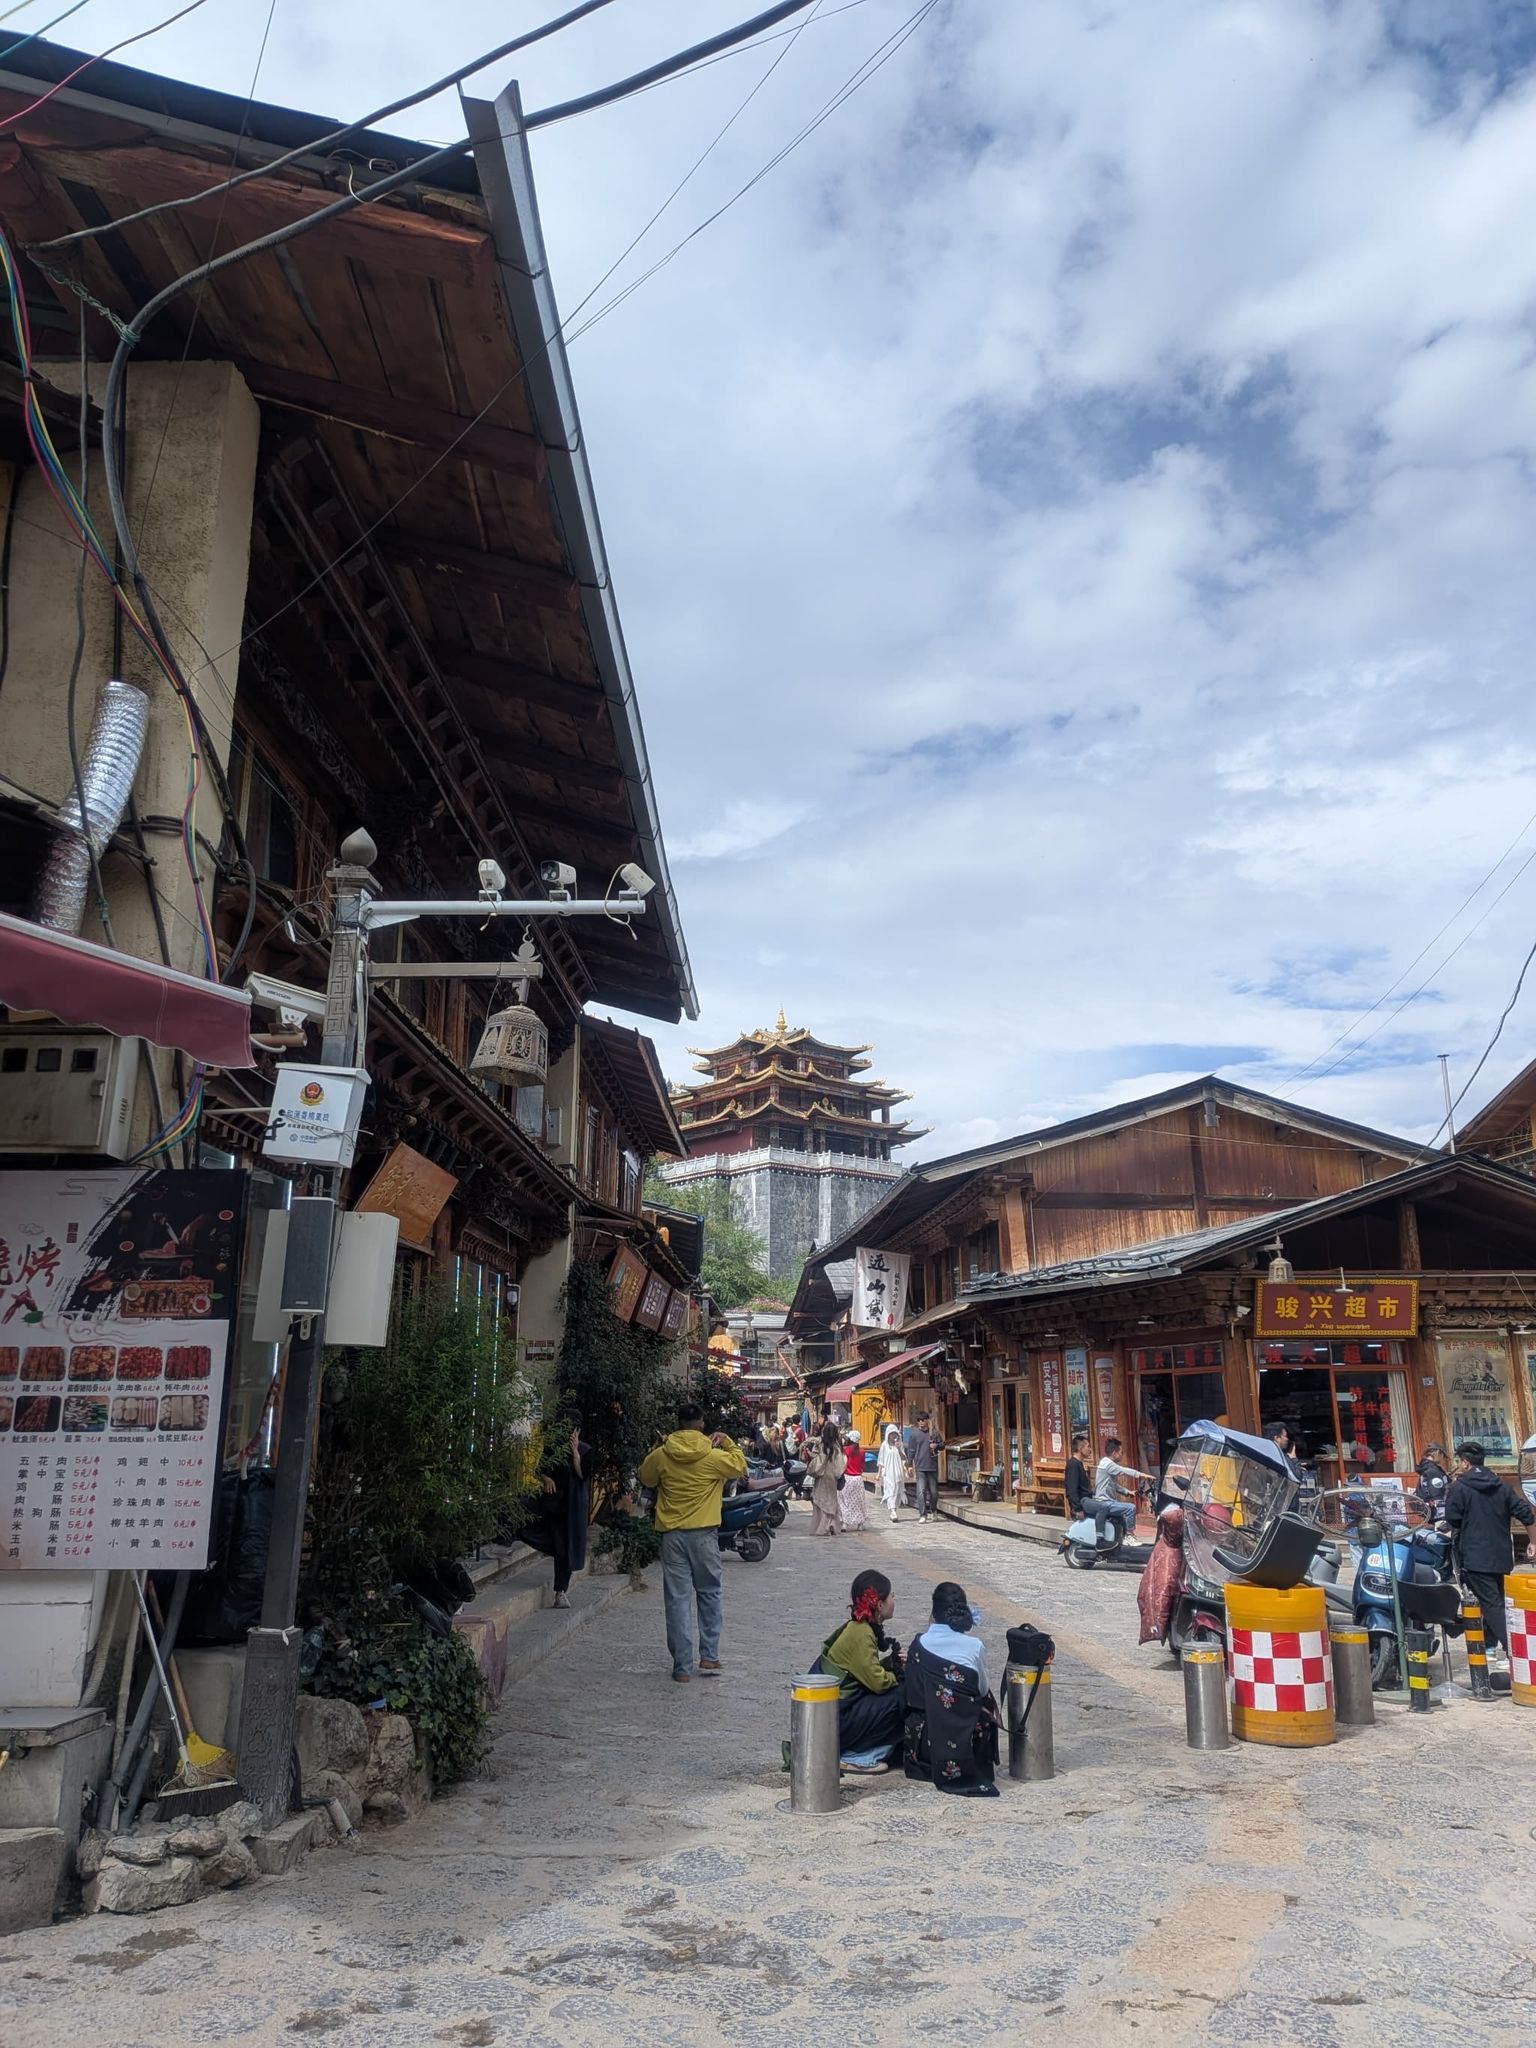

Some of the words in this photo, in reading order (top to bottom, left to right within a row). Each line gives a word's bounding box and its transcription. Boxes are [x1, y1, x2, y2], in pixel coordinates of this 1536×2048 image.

[866, 1253, 890, 1322] 远山黛
[1275, 1296, 1399, 1319] 骏兴超市
[1068, 1370, 1085, 1387] 超市
[116, 1384, 142, 1392] 羊肉串
[19, 1456, 67, 1466] 五花肉
[117, 1457, 169, 1467] 鸡翅中
[18, 1468, 66, 1479] 掌中宝
[16, 1481, 64, 1492] 鸡皮
[114, 1477, 167, 1487] 小肉串
[14, 1495, 62, 1505] 肉肠
[112, 1497, 165, 1507] 珍珠肉串
[13, 1508, 61, 1518] 热狗肠
[12, 1521, 60, 1531] 米肠
[110, 1518, 163, 1528] 柳枝羊肉
[108, 1539, 161, 1549] 小黄鱼
